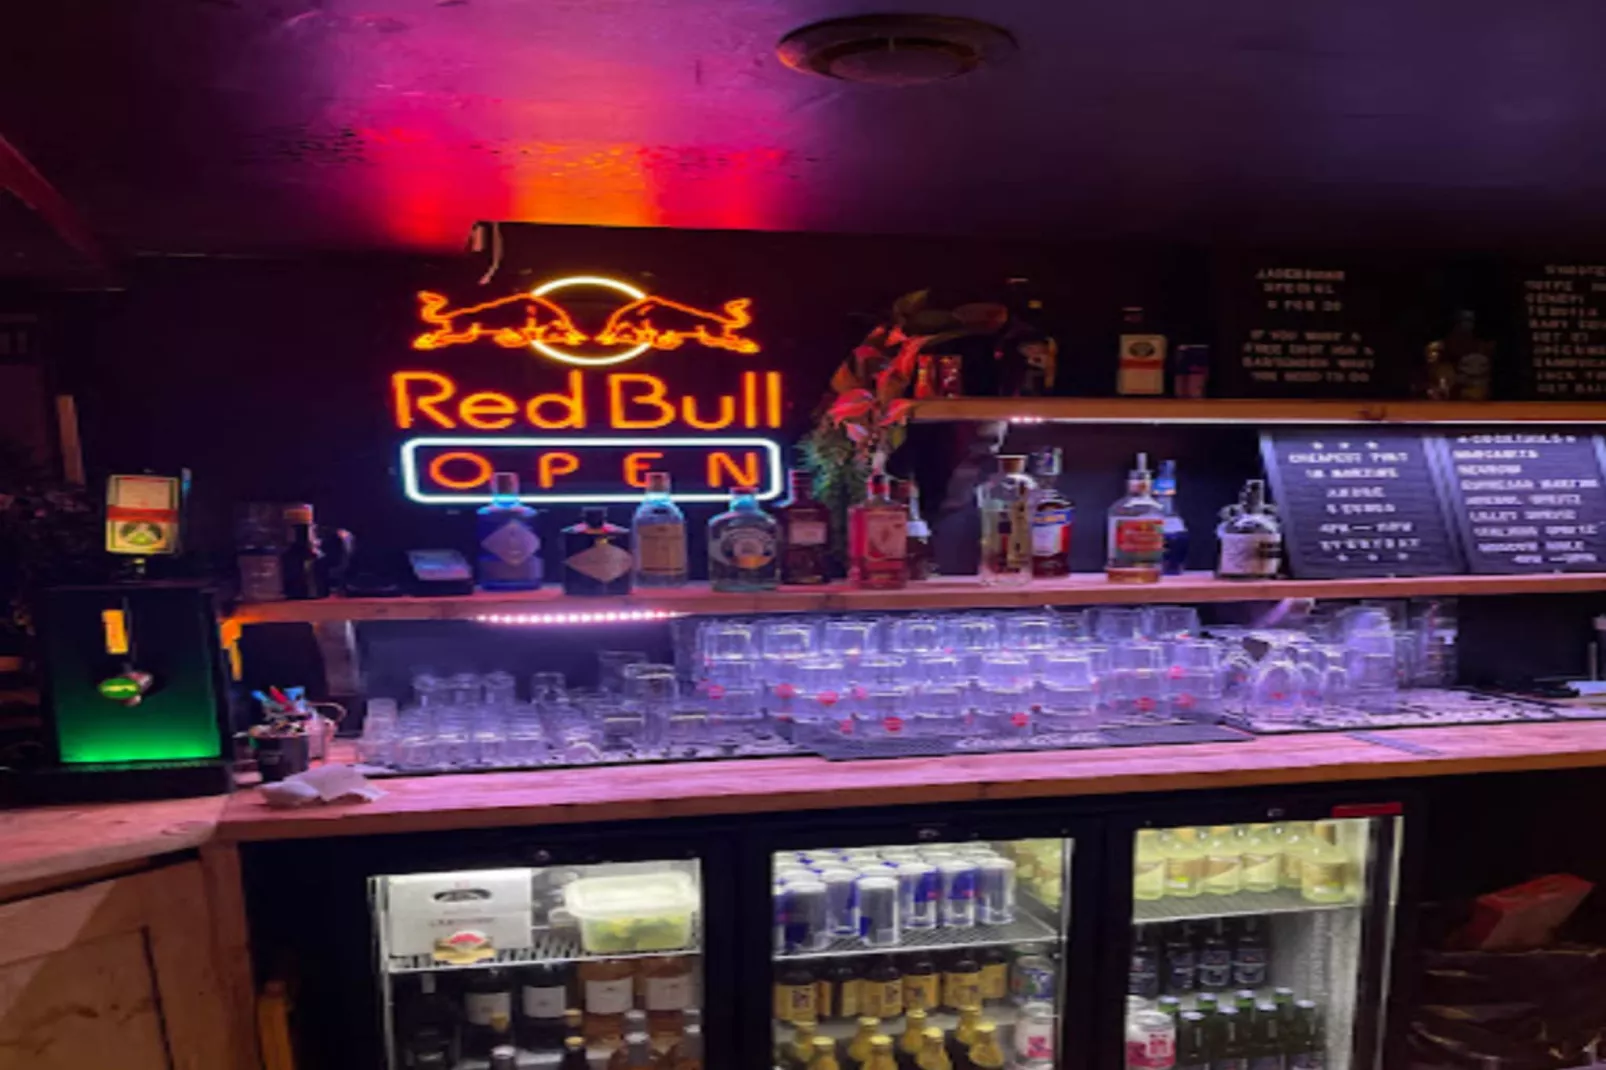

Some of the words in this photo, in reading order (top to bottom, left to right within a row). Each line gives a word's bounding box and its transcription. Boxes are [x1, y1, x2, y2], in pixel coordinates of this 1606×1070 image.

[390, 369, 586, 430] Red
[606, 369, 782, 430] Bull
[427, 451, 760, 489] OPEN
